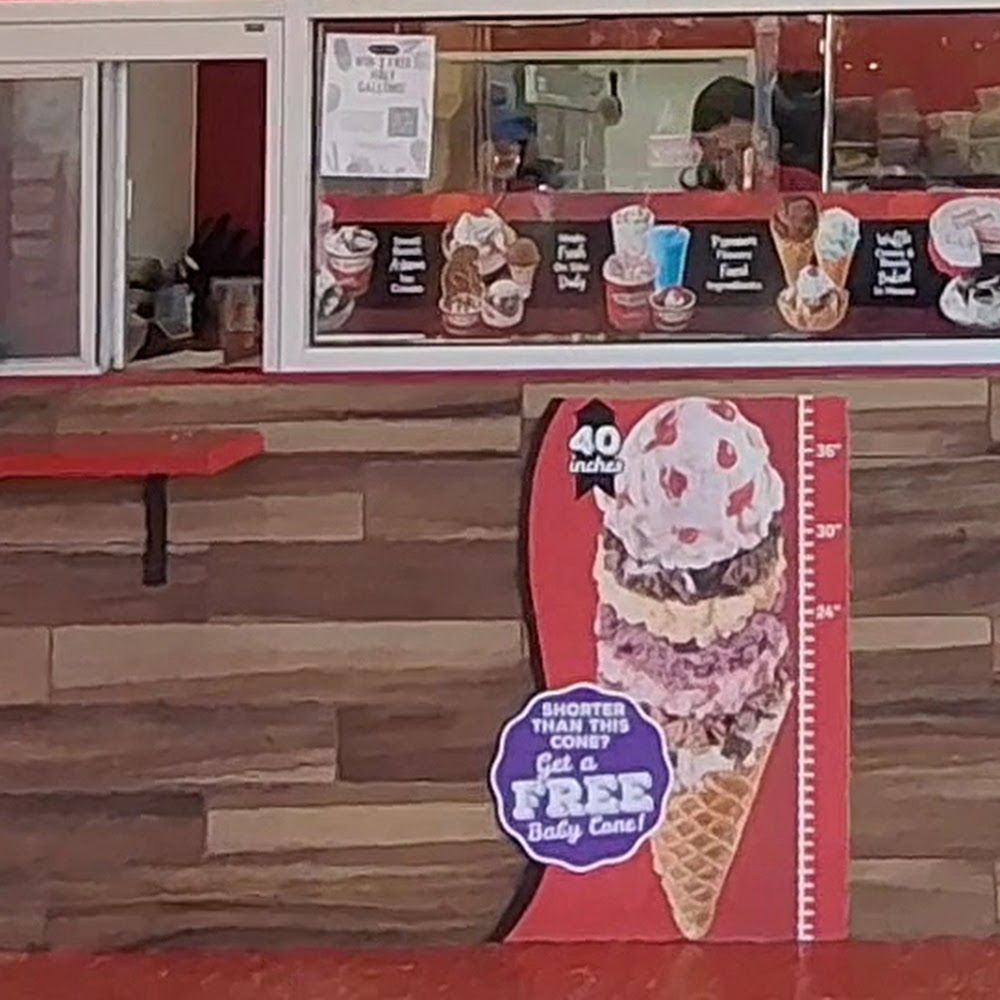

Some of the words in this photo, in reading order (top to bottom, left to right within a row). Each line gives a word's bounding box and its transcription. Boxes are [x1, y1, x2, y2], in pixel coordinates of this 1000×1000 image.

[569, 425, 621, 456] 40
[816, 443, 842, 458] 36"
[569, 455, 624, 473] inches
[816, 524, 842, 538] 30"
[816, 604, 841, 619] 24"
[542, 702, 626, 716] SHORTER
[531, 719, 583, 733] THAN
[589, 719, 630, 733] THIS
[550, 735, 610, 749] CONE?
[536, 752, 574, 780] Get
[580, 756, 598, 771] a
[511, 772, 654, 820] FREE
[527, 819, 584, 845] Baby
[589, 813, 645, 835] Cone!
